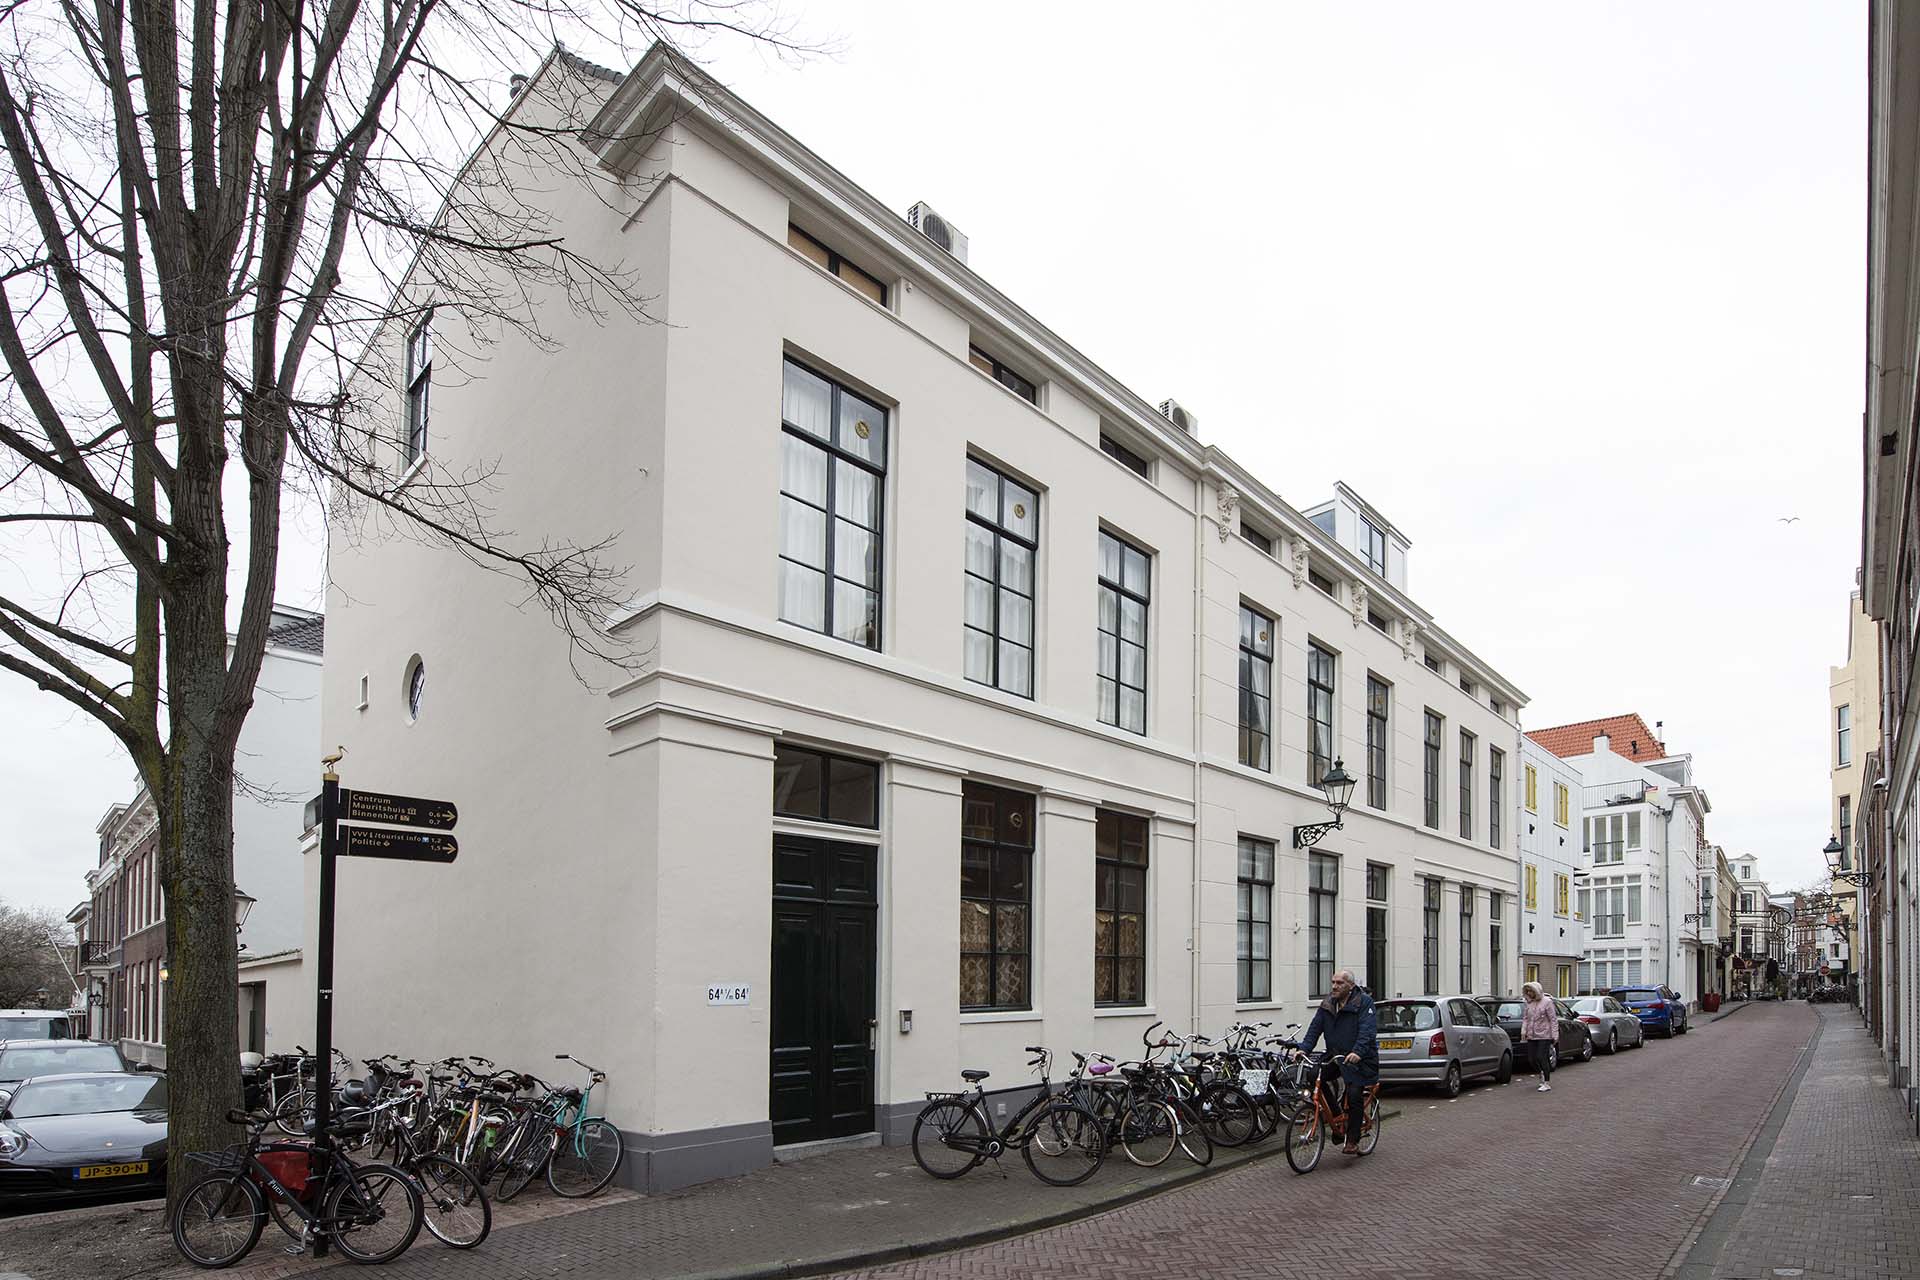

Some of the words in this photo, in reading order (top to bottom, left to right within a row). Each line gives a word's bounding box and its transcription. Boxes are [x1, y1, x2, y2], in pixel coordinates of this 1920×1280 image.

[353, 794, 391, 804] Centrum
[352, 801, 406, 814] Mauritshuis
[352, 809, 399, 820] Binnenhof
[351, 837, 382, 847] Politie
[84, 1163, 144, 1177] JP-390-N
